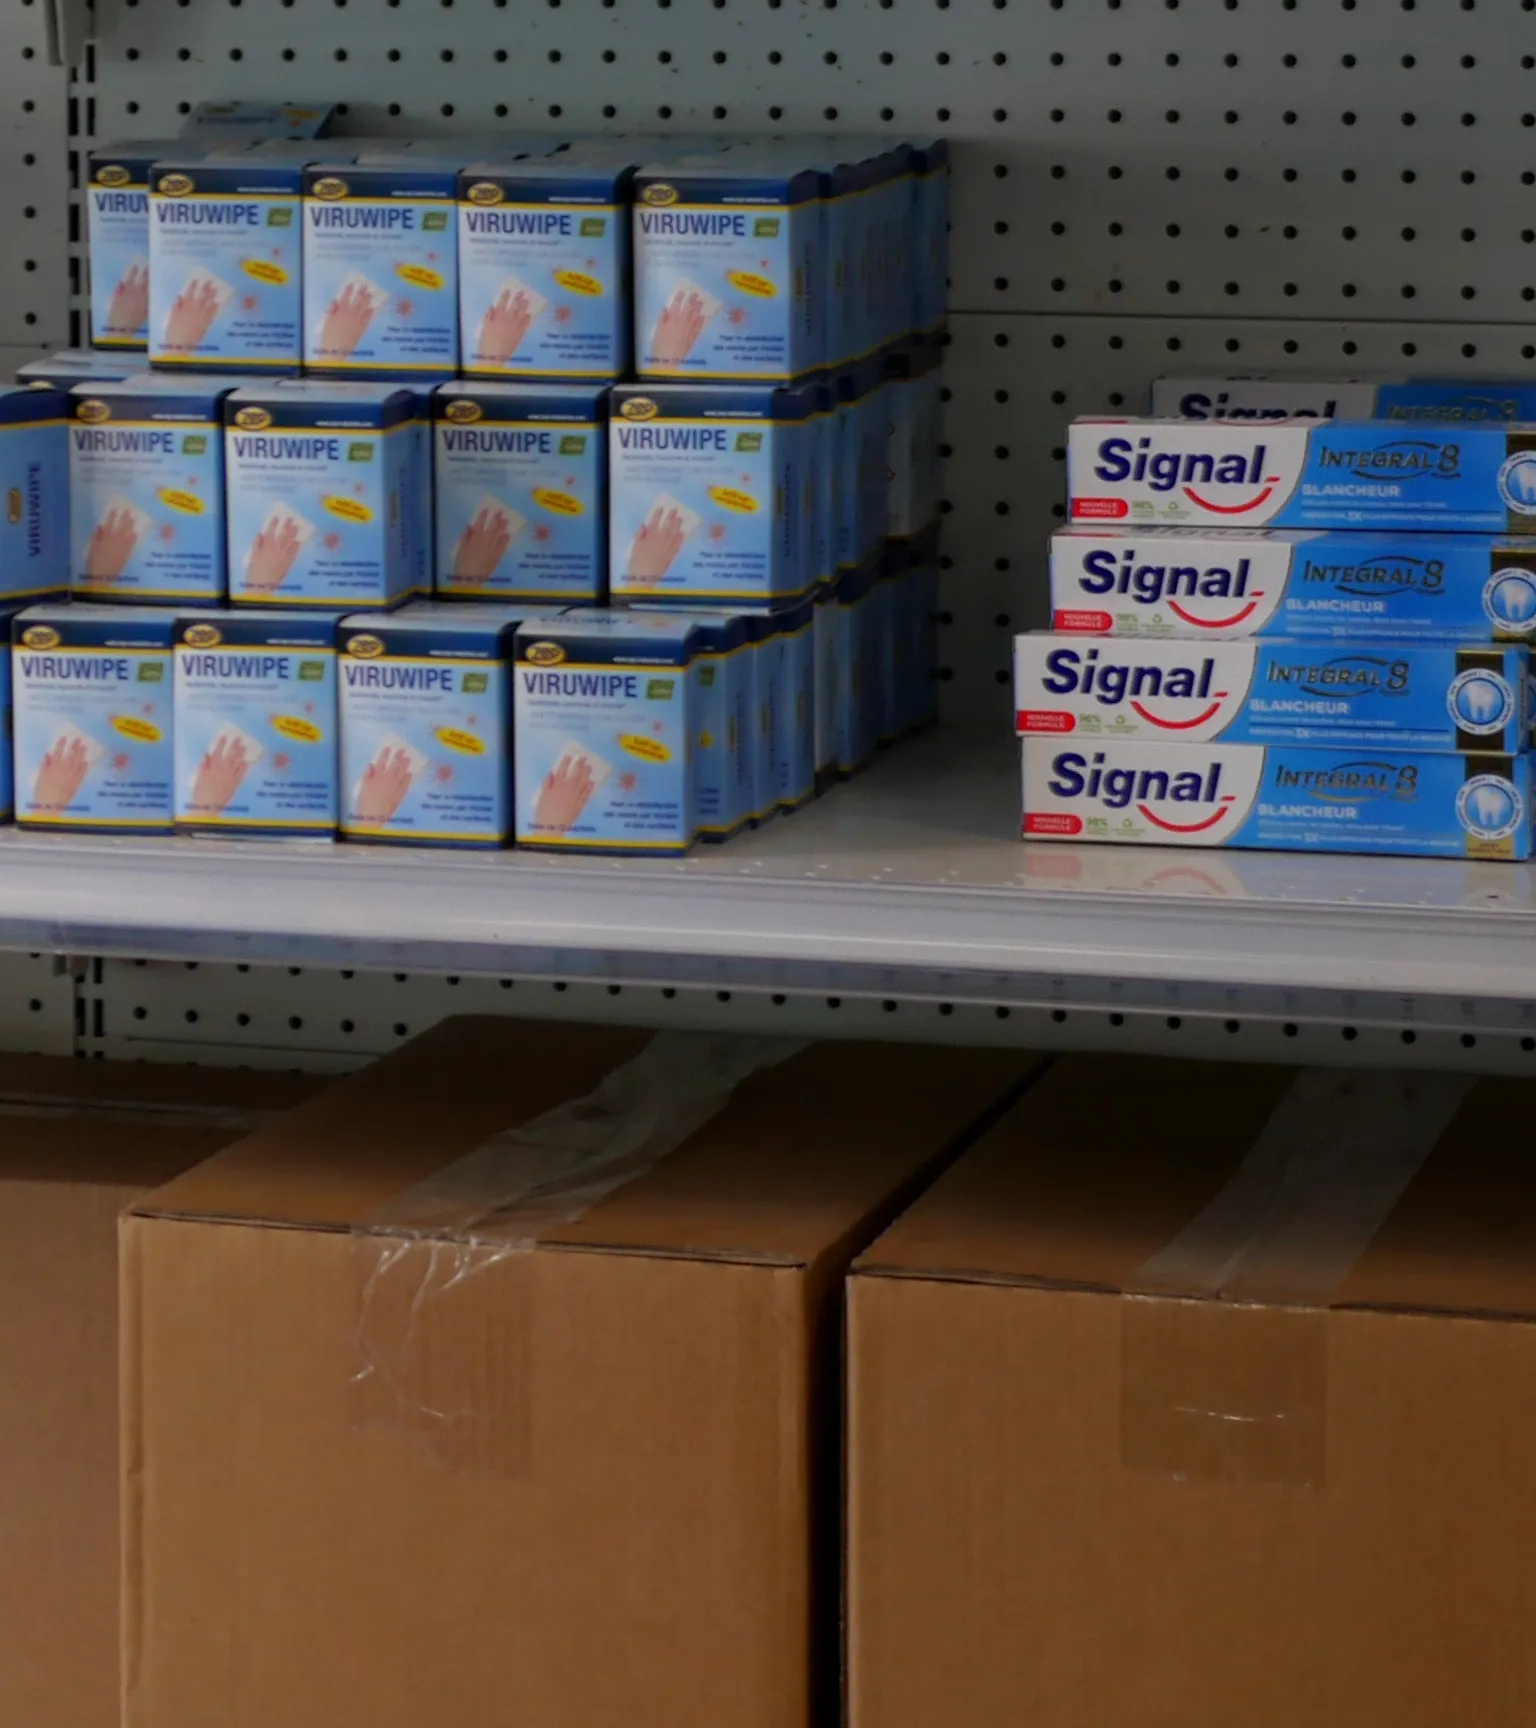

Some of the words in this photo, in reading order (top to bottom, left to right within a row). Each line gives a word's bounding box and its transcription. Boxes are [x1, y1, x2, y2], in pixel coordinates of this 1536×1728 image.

[156, 203, 260, 226] VIRUWIPE
[310, 206, 415, 230] VIRUWIPE
[465, 211, 572, 237] VIRUWIPE
[639, 212, 746, 237] VIRUWIPE
[73, 429, 175, 454] VIRUWIPE
[233, 436, 340, 460] VIRUWIPE
[442, 429, 551, 454] VIRUWIPE
[617, 427, 727, 451] VIRUWIPE
[1093, 437, 1267, 492] Signal
[1319, 446, 1434, 469] INTEGRAL
[1437, 444, 1461, 473] 8
[1302, 484, 1401, 497] BLANCHEUR
[1078, 550, 1251, 605] Signal
[1303, 560, 1419, 585] INTEGRAL
[1424, 558, 1445, 588] 8
[1286, 598, 1385, 613] BLANCHEUR
[21, 656, 129, 681] VIRUWIPE
[181, 654, 290, 680] VIRUWIPE
[344, 665, 454, 691] VIRUWIPE
[1041, 647, 1215, 705] Signal
[1267, 660, 1382, 685] INTEGRAL
[1386, 660, 1410, 690] 8
[523, 673, 637, 698] VIRUWIPE
[1249, 699, 1349, 715] BLANCHEUR
[1047, 752, 1222, 809] Signal
[1276, 765, 1389, 788] INTEGRAL
[1395, 765, 1419, 795] 8
[1257, 804, 1357, 819] BLANCHEUR
